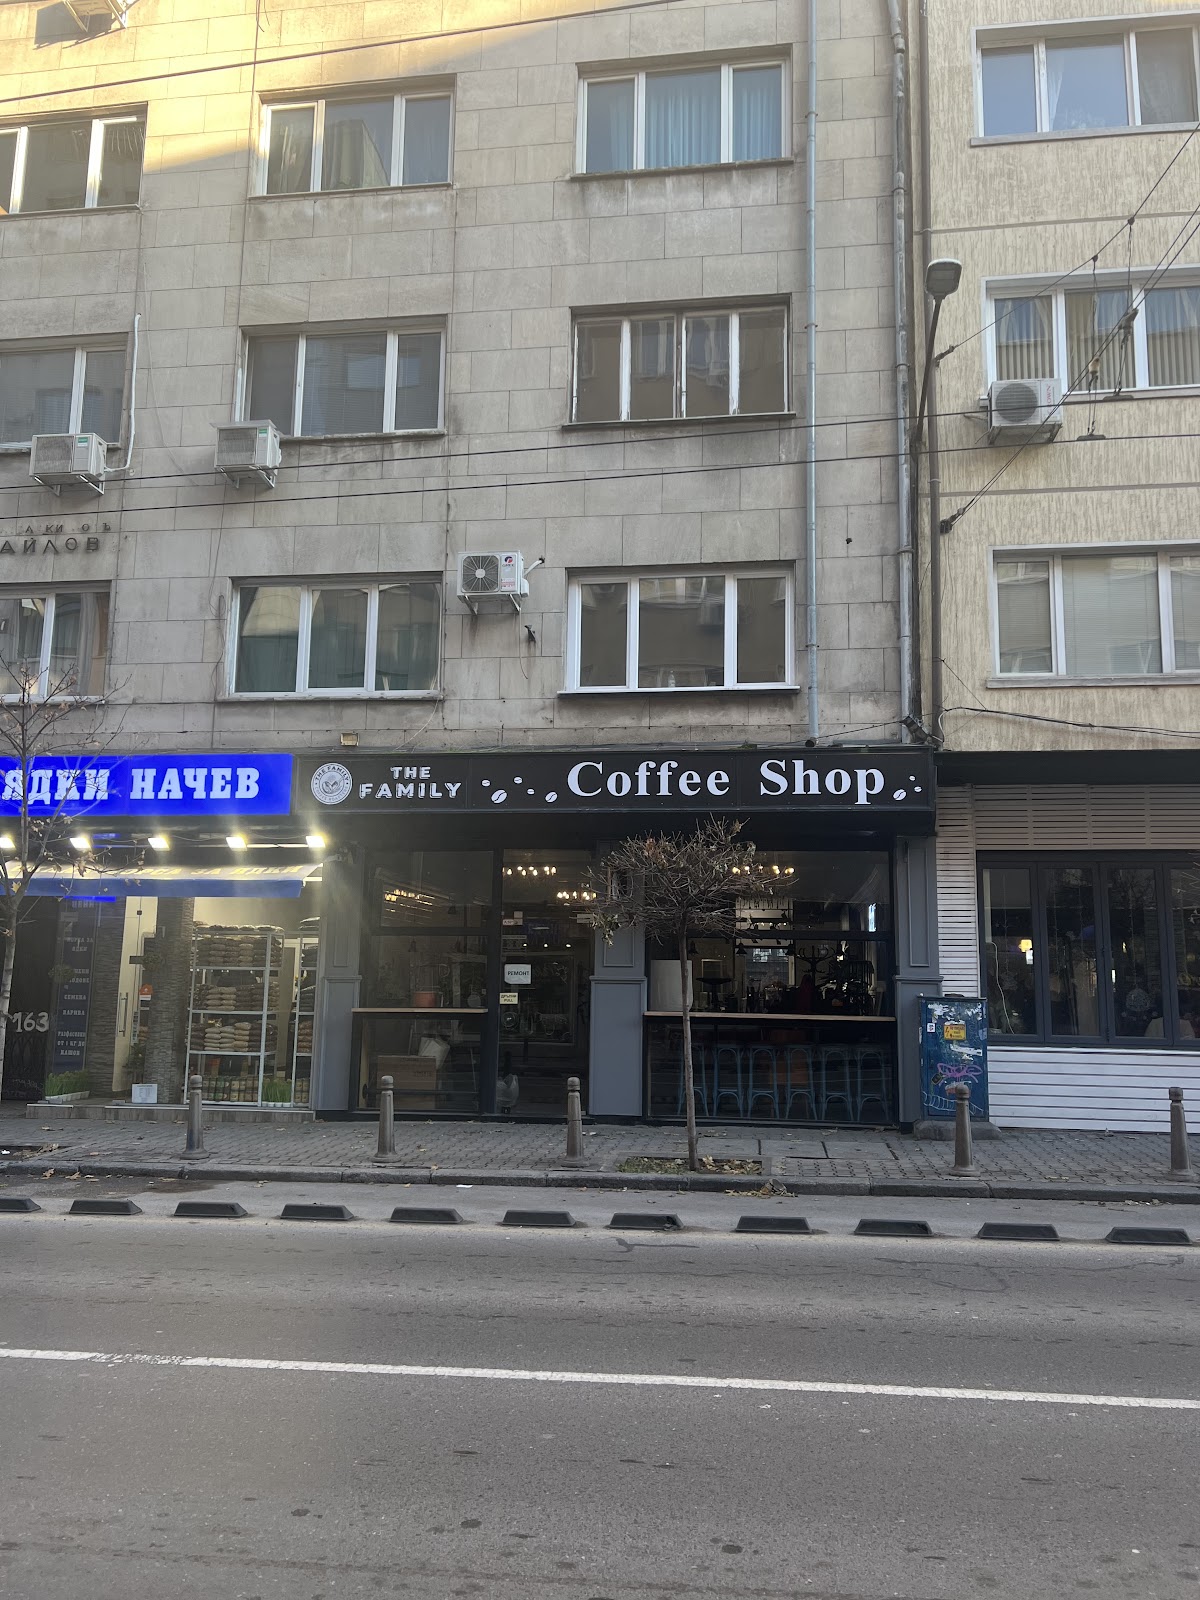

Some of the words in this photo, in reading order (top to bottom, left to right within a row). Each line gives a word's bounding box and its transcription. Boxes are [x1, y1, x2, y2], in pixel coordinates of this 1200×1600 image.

[327, 766, 349, 781] FAMILY
[390, 766, 431, 780] THE
[567, 761, 730, 797] Coffee
[760, 759, 885, 805] Shop
[2, 768, 110, 805] ЯДКИ
[130, 767, 260, 799] НАЧЕВ
[359, 783, 462, 799] FAMILY
[12, 1011, 49, 1032] 163
